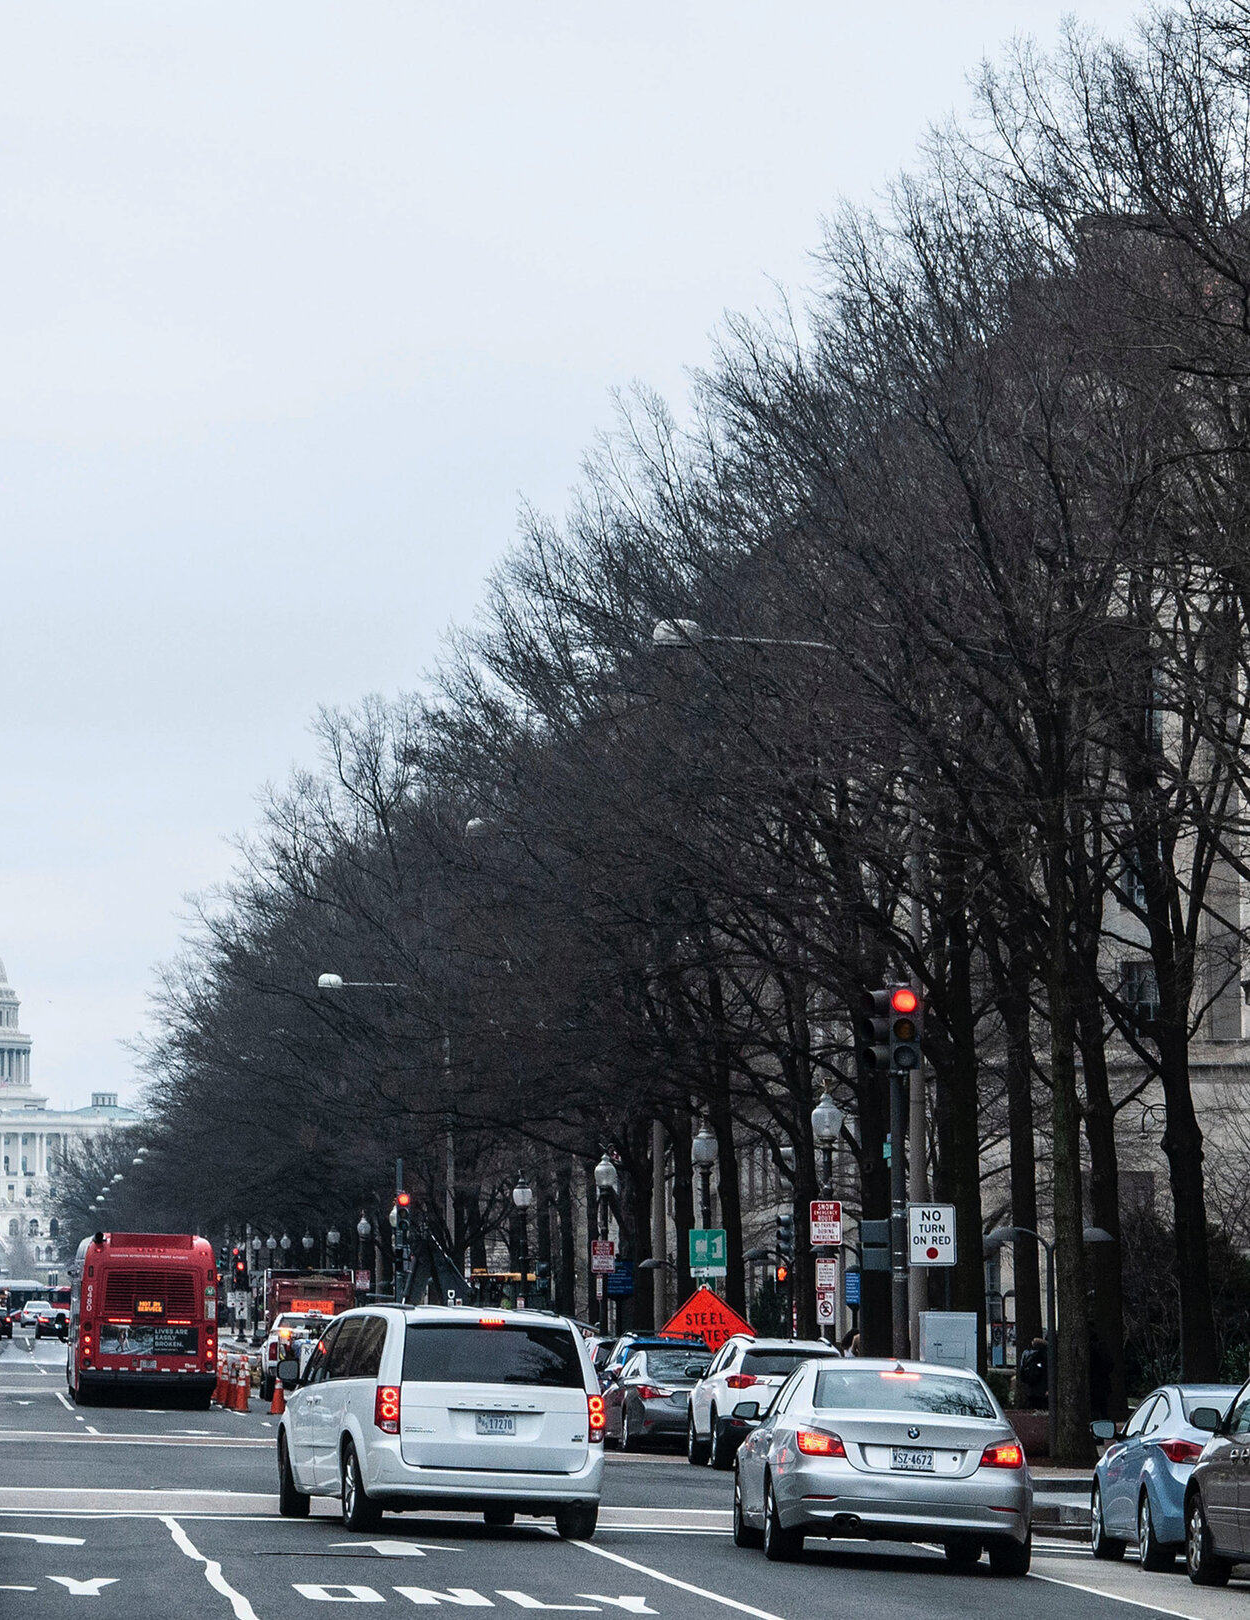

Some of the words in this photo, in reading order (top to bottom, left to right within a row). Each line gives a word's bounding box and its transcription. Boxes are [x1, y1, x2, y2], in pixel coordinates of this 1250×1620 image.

[921, 1210, 941, 1221] NO
[919, 1224, 945, 1233] TURN
[913, 1236, 926, 1245] ON
[931, 1236, 951, 1245] RED
[685, 1313, 726, 1325] STEEL
[489, 1418, 513, 1430] 17270
[291, 1584, 660, 1615] ONLY
